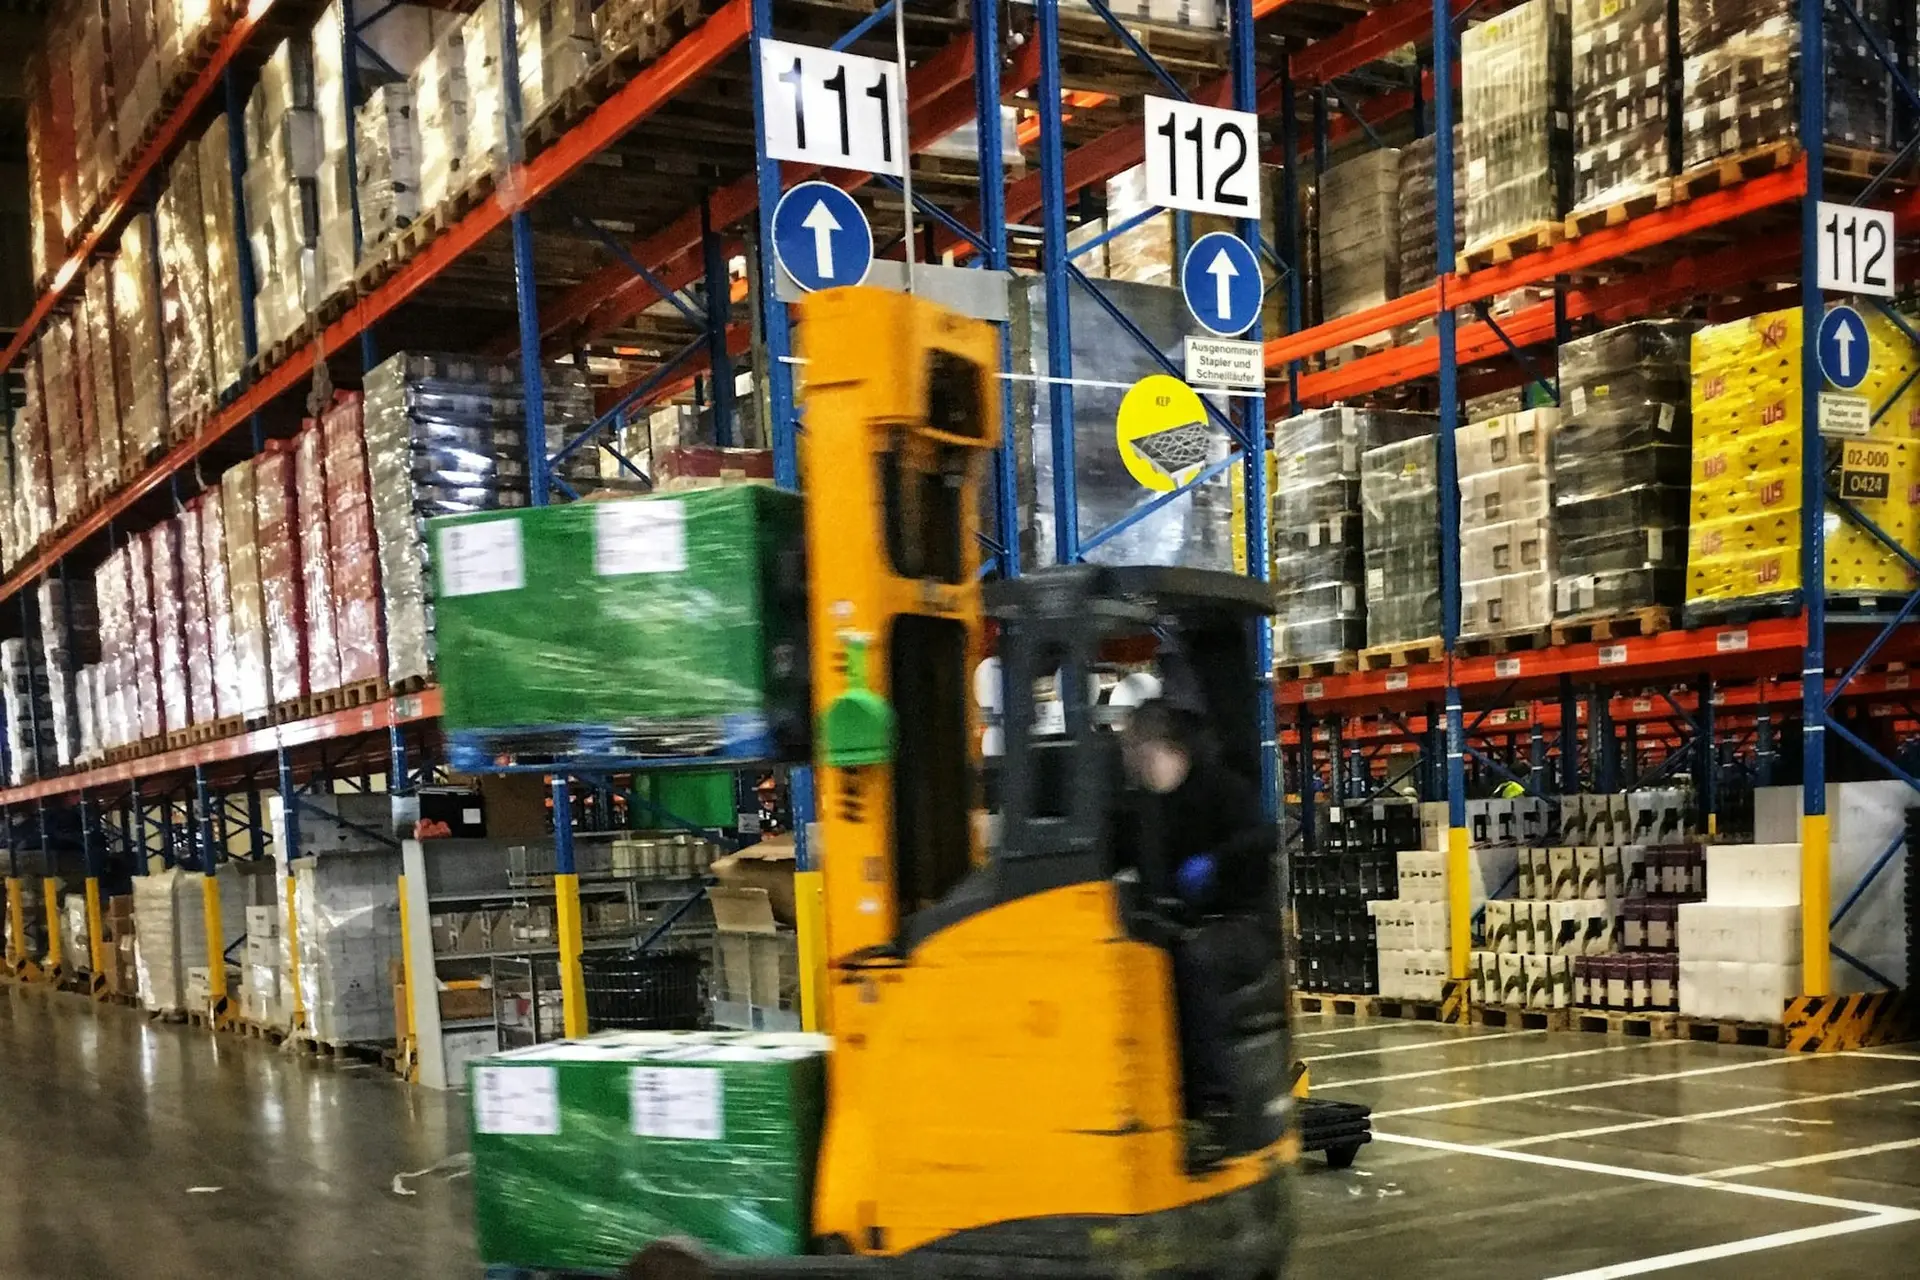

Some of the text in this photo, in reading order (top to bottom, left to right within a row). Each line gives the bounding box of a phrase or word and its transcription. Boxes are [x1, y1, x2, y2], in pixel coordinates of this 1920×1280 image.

[779, 57, 892, 162] 111
[1158, 112, 1248, 206] 112
[1826, 213, 1887, 287] 112
[1191, 342, 1259, 356] Ausgenommen
[1199, 356, 1252, 369] Stapler und
[1847, 449, 1889, 467] 02-000
